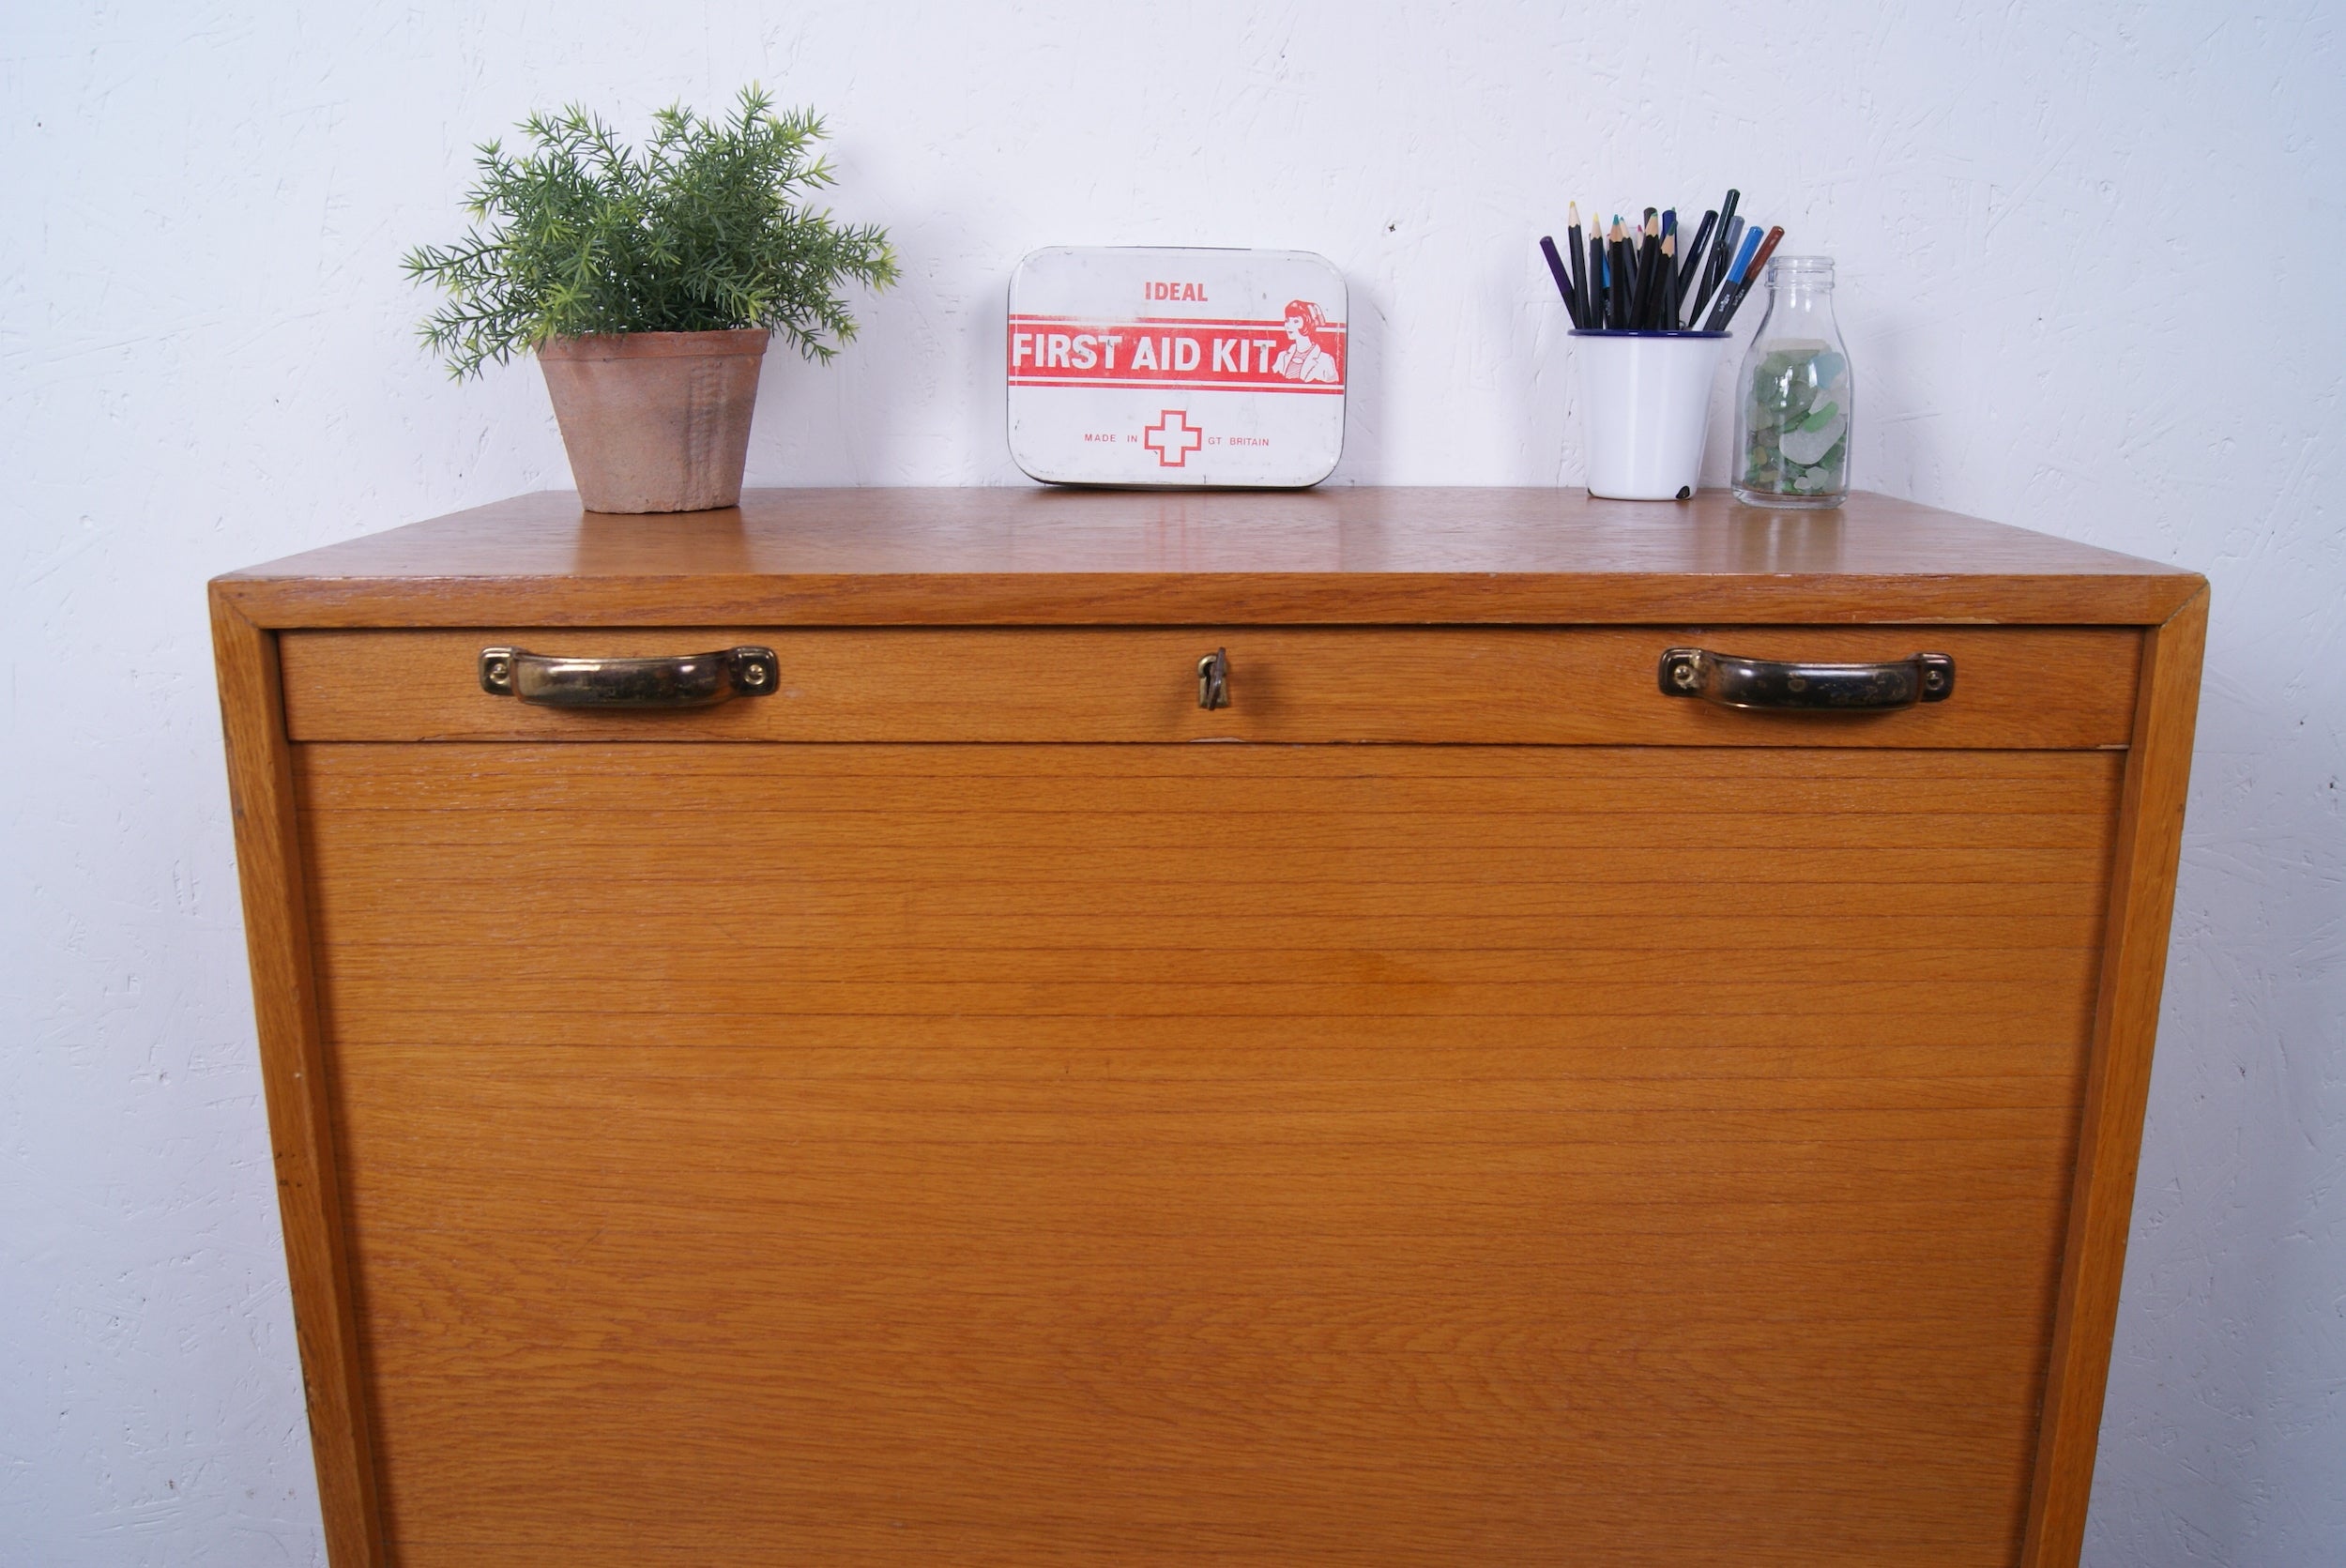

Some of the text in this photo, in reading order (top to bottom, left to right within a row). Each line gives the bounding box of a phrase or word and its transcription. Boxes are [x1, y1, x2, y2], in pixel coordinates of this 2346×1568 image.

[1145, 282, 1209, 302] IDEAL
[1013, 332, 1277, 373] FIRST AID KIT
[1084, 434, 1270, 447] MADE IN GT BRITAIN
